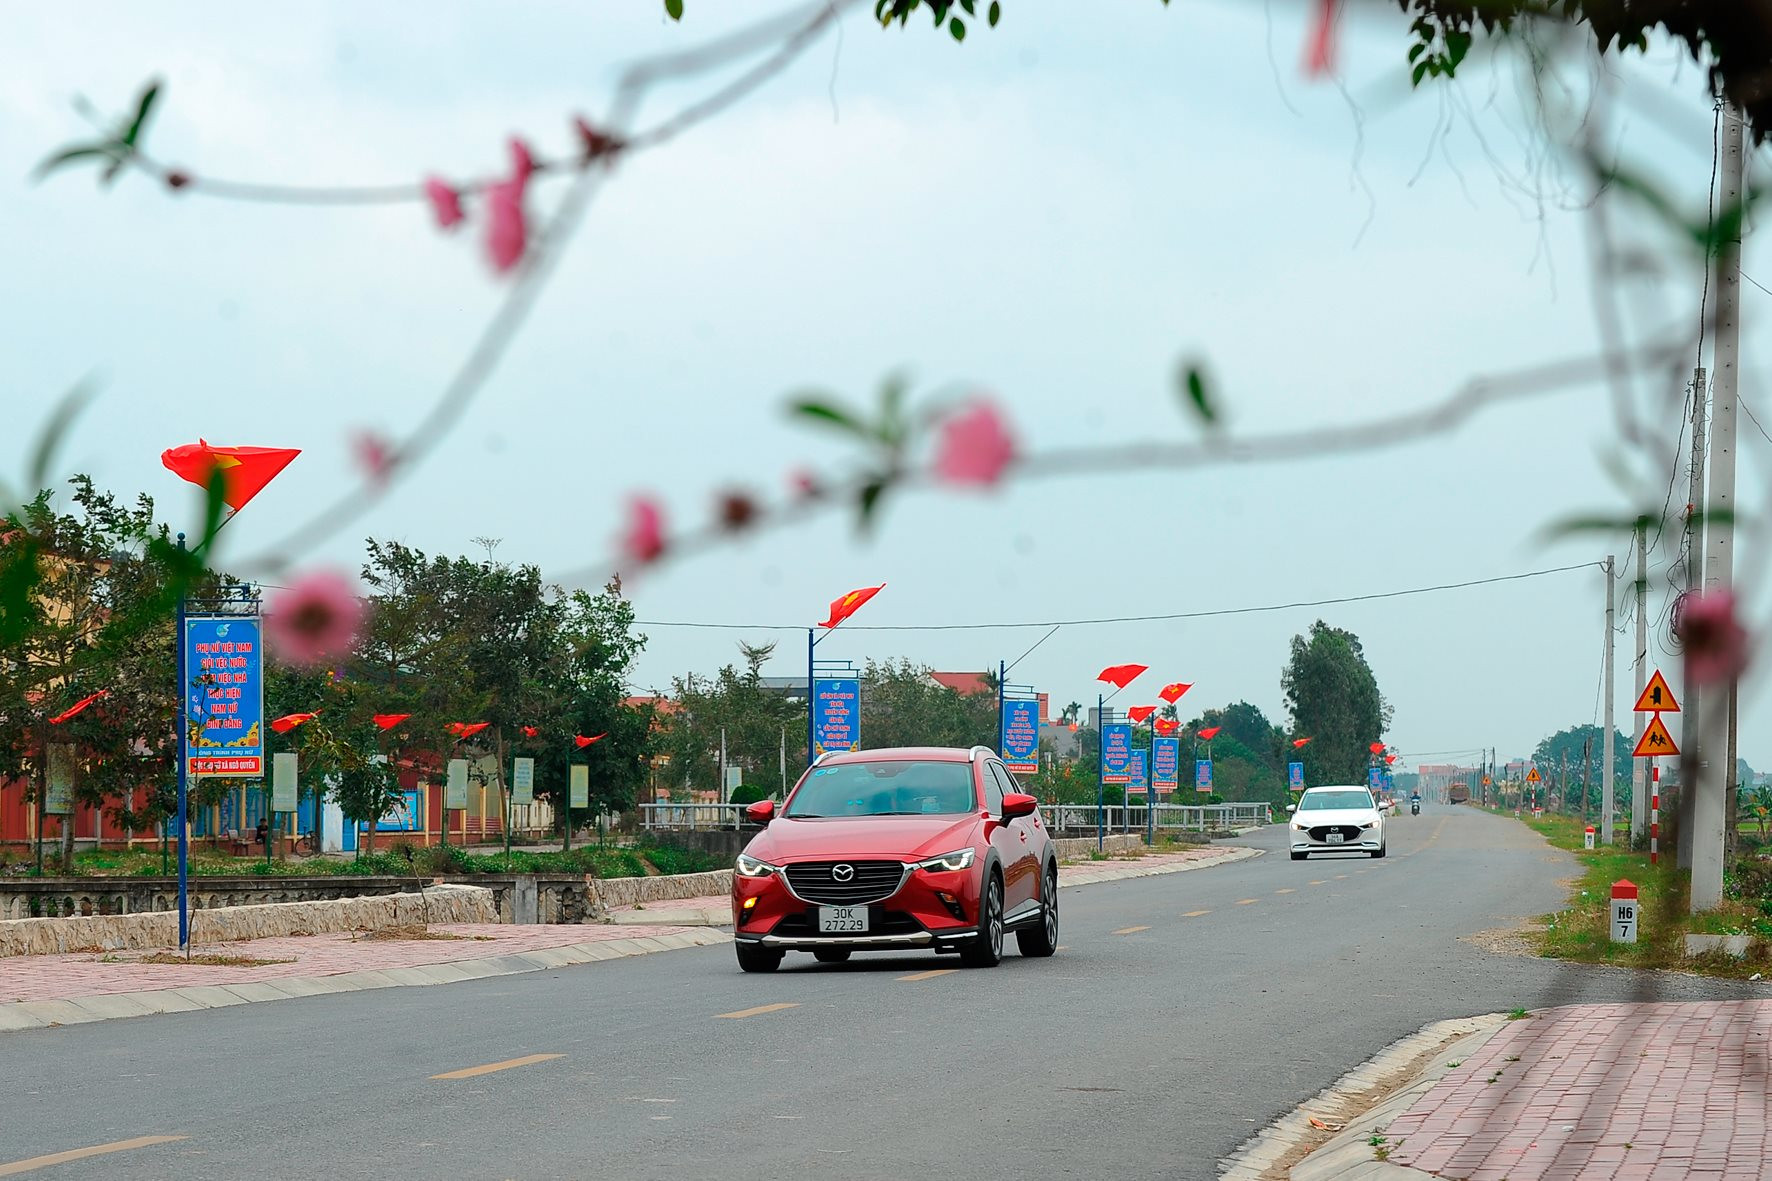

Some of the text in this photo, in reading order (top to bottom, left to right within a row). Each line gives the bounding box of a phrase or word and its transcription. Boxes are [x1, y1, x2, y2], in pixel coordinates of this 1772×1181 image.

[196, 640, 252, 655] PHỤ NỮ VIỆT NAM
[225, 687, 241, 700] HIỆN
[211, 701, 238, 714] NAM NỮ
[833, 908, 854, 919] 30K
[1618, 906, 1633, 920] H6
[825, 920, 863, 931] 272.29
[1621, 925, 1629, 938] 7
